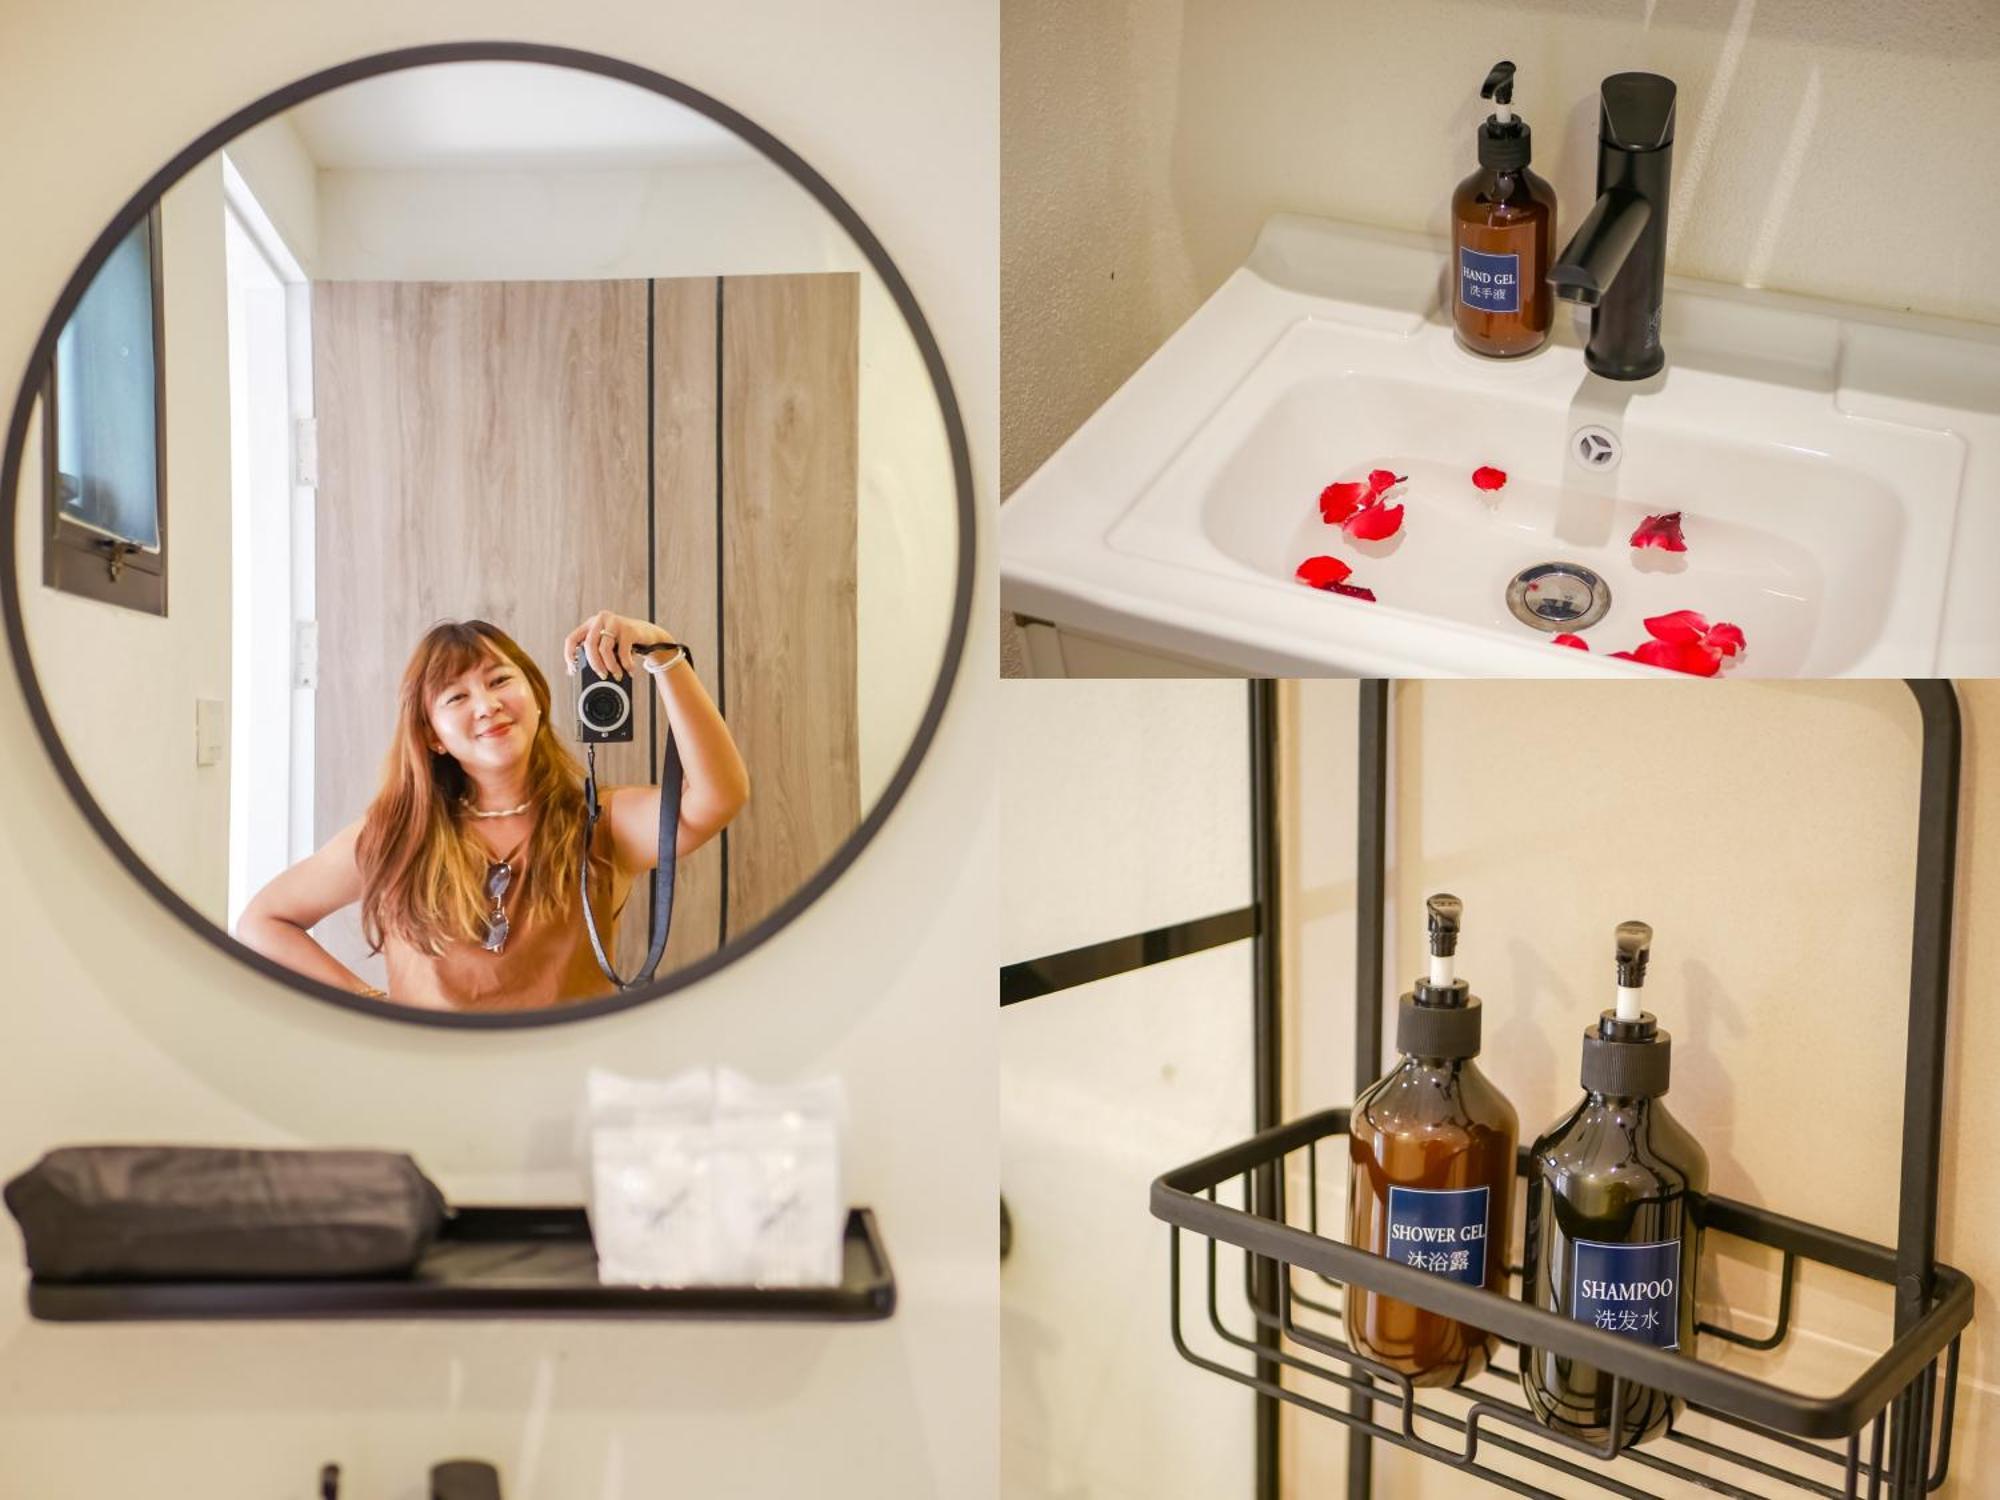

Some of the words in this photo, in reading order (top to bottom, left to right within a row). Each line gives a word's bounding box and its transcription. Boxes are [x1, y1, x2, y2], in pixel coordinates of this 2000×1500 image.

[1463, 266, 1491, 284] HAND
[1494, 274, 1515, 285] GEL
[1391, 1223, 1456, 1243] SHOWER
[1460, 1223, 1486, 1240] GEL
[1407, 1249, 1470, 1272] 沐浴露
[1581, 1278, 1673, 1301] SHAMPOO
[1594, 1307, 1660, 1332] 洗发水
